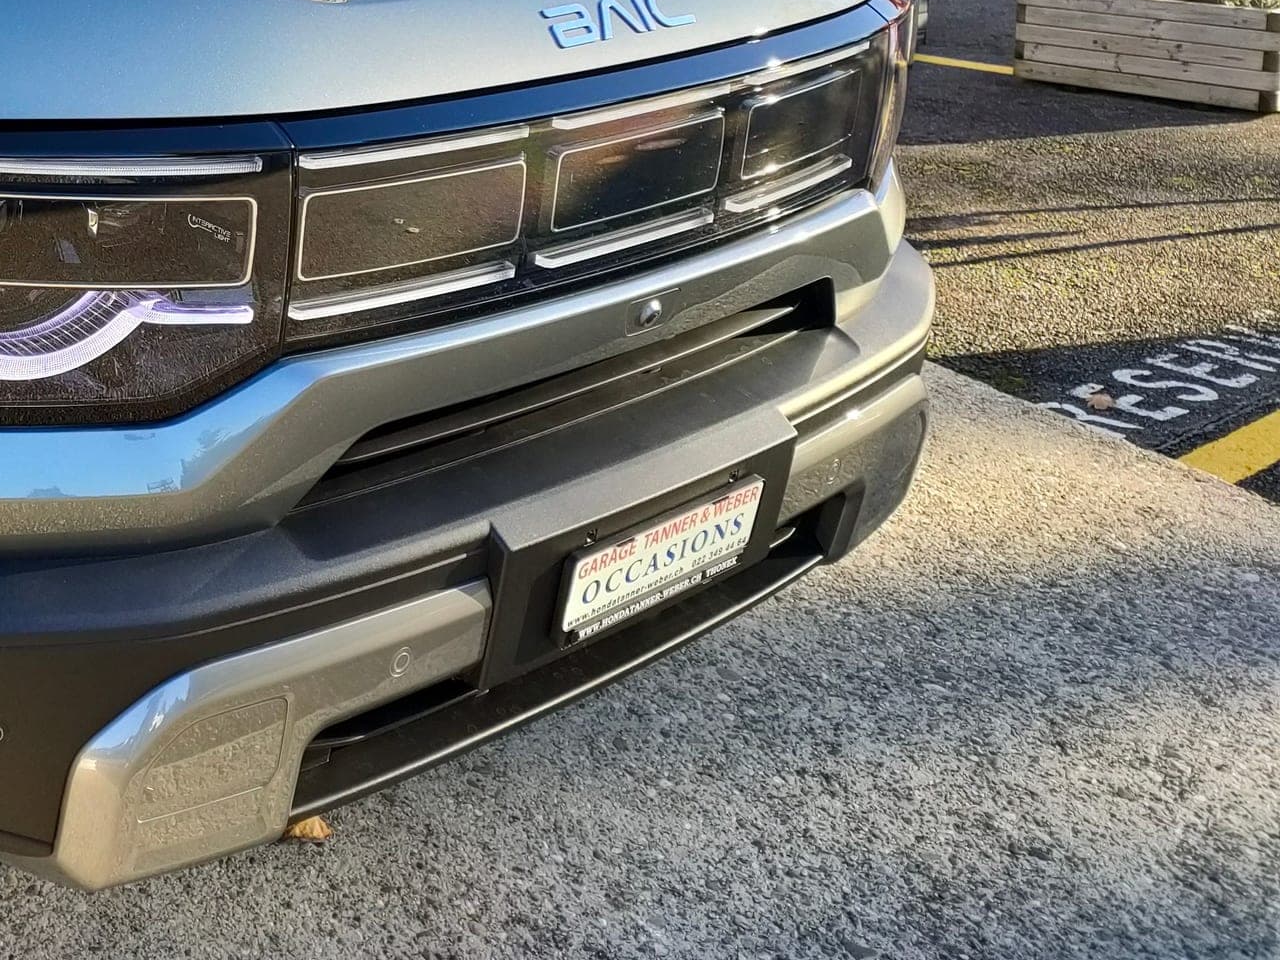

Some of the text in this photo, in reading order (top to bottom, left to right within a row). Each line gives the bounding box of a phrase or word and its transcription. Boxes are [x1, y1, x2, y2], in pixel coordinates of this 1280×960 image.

[578, 486, 760, 580] GARAGE TANNER & WEBER
[582, 512, 744, 604] OCCASIONS
[567, 567, 684, 627] www.hondatanner-weber.ch
[691, 554, 707, 568] 022
